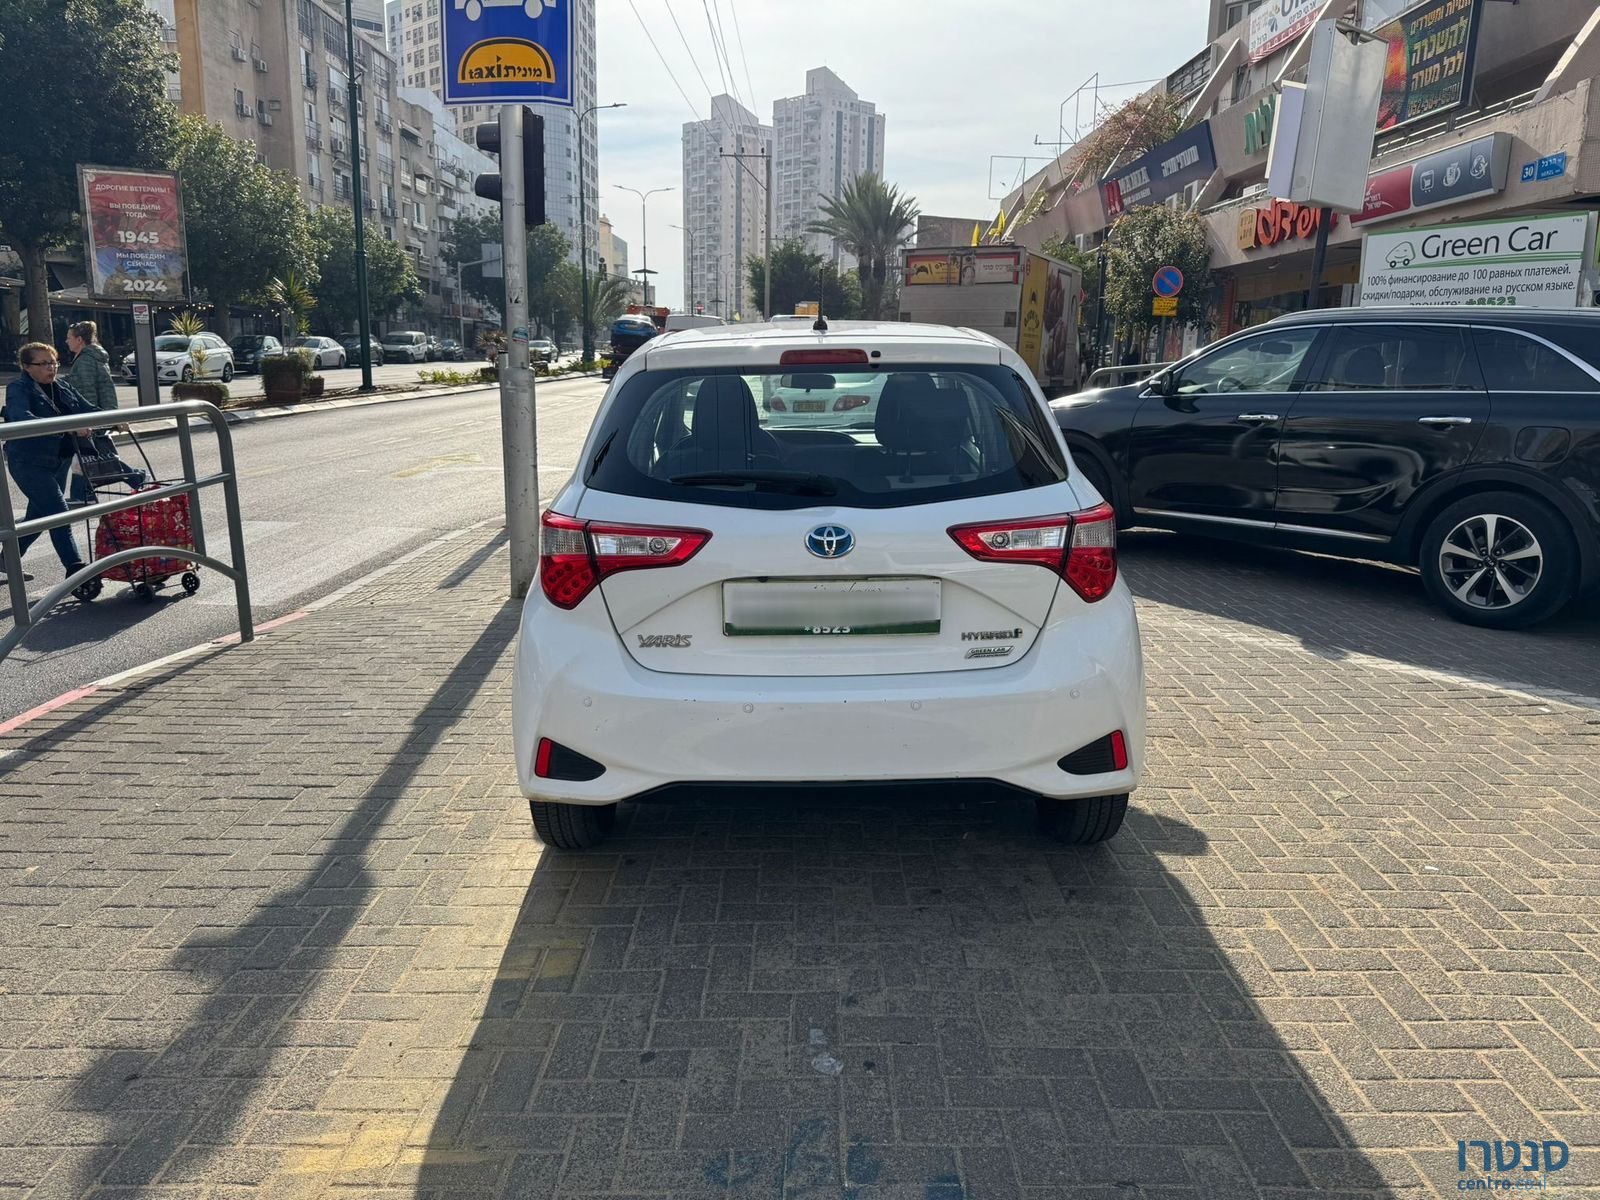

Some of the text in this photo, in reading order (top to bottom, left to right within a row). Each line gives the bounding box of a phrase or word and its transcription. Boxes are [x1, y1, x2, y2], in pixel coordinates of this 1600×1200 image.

[1410, 5, 1444, 35] ומשרדים
[1411, 16, 1469, 66] להשכרה
[468, 61, 502, 79] taxi
[503, 65, 543, 78] מונית
[1411, 50, 1464, 91] לכל מטרה
[1523, 166, 1534, 178] 30
[95, 183, 129, 191] ДОРОГИЕ
[129, 185, 166, 193] ВЕТЕРАНЫ
[117, 230, 160, 244] 1945
[1421, 226, 1558, 259] Green Car
[1367, 264, 1571, 287] 100% финансирование до 100 равных платежей.
[123, 279, 168, 292] 2024
[1362, 281, 1575, 301] скидки/подарки, обслуживание на русском языке.
[637, 634, 693, 648] YARIS
[961, 630, 1014, 641] HYBRID
